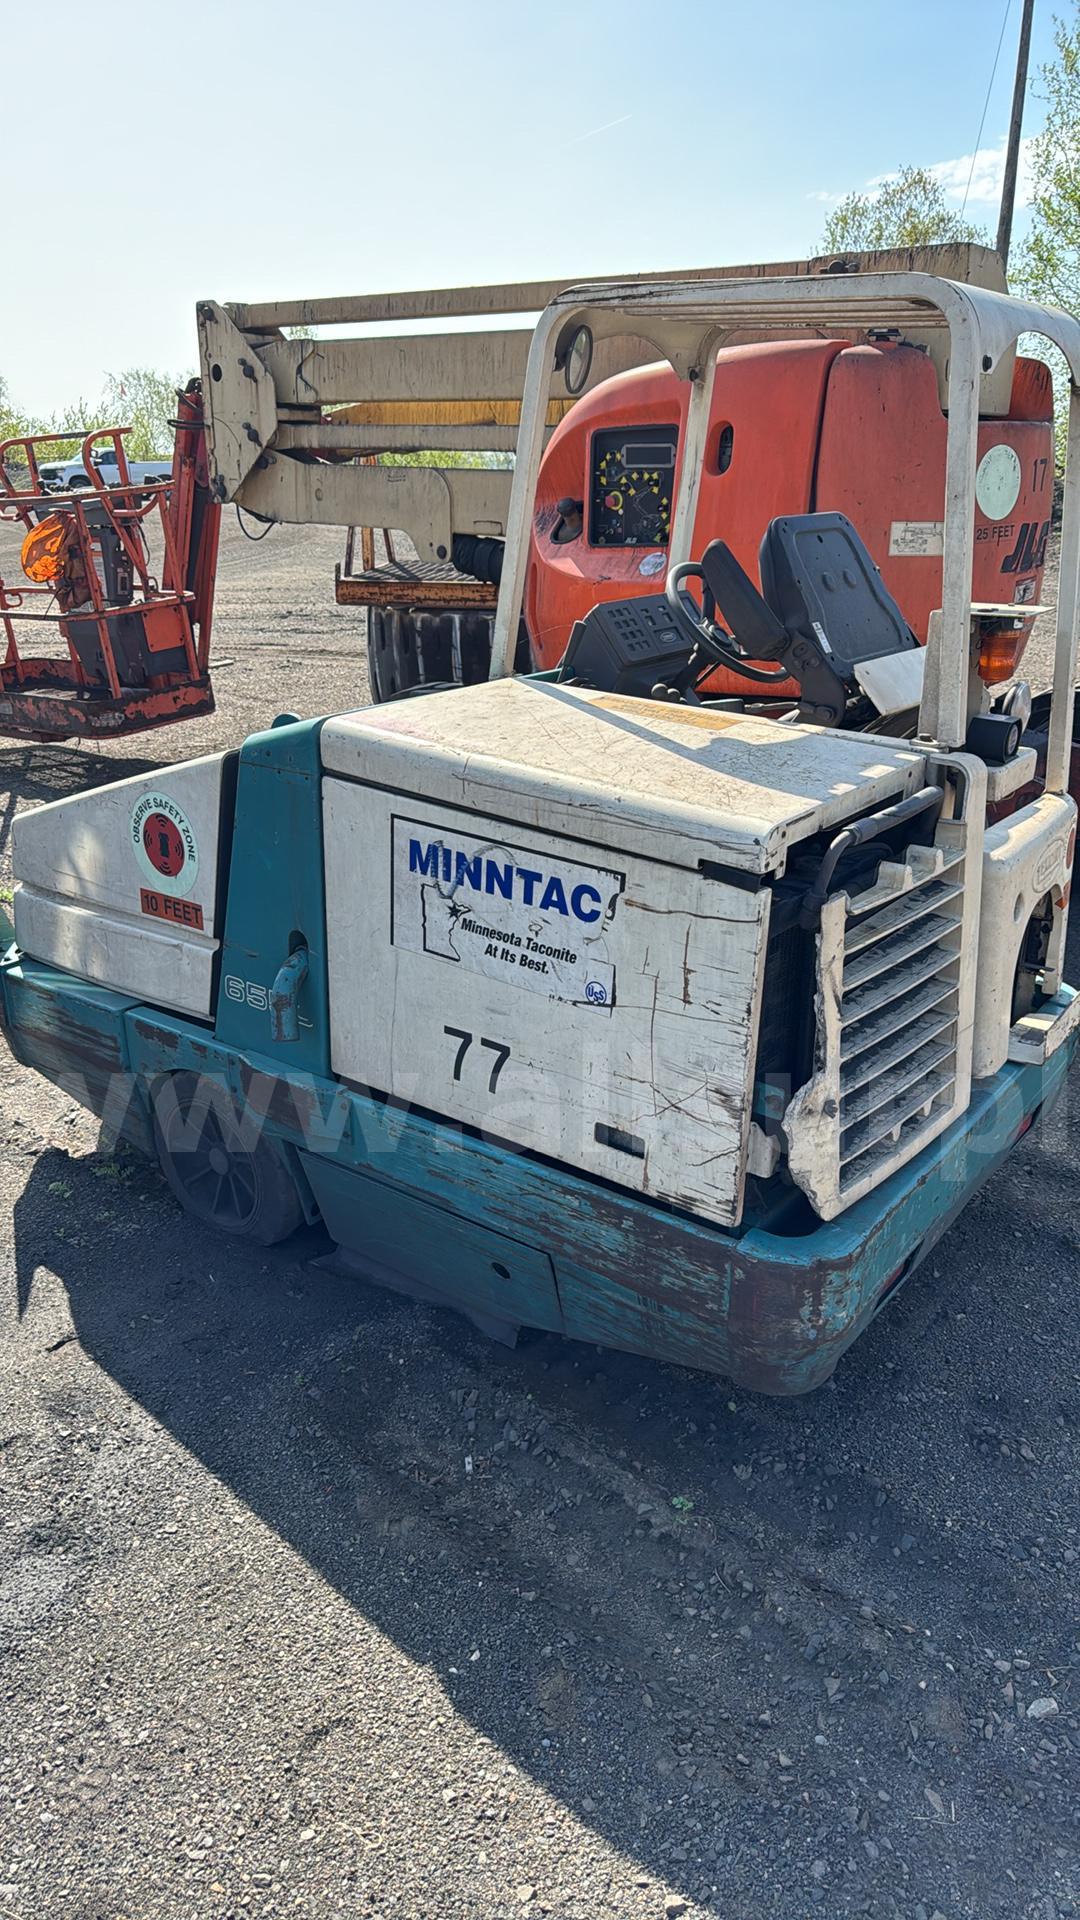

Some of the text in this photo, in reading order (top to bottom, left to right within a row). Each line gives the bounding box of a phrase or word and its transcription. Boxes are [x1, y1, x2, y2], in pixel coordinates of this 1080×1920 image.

[1032, 458, 1048, 492] 17
[976, 525, 1015, 541] 25 FEET
[132, 797, 196, 863] OBSERVE SAFETY ZONE
[408, 838, 602, 924] MINNTAC
[143, 893, 202, 925] 10 FEET
[460, 916, 578, 965] Minnesota Taconite
[484, 944, 550, 975] At Its Best.
[586, 984, 605, 1003] USS
[443, 1025, 511, 1095] 77
